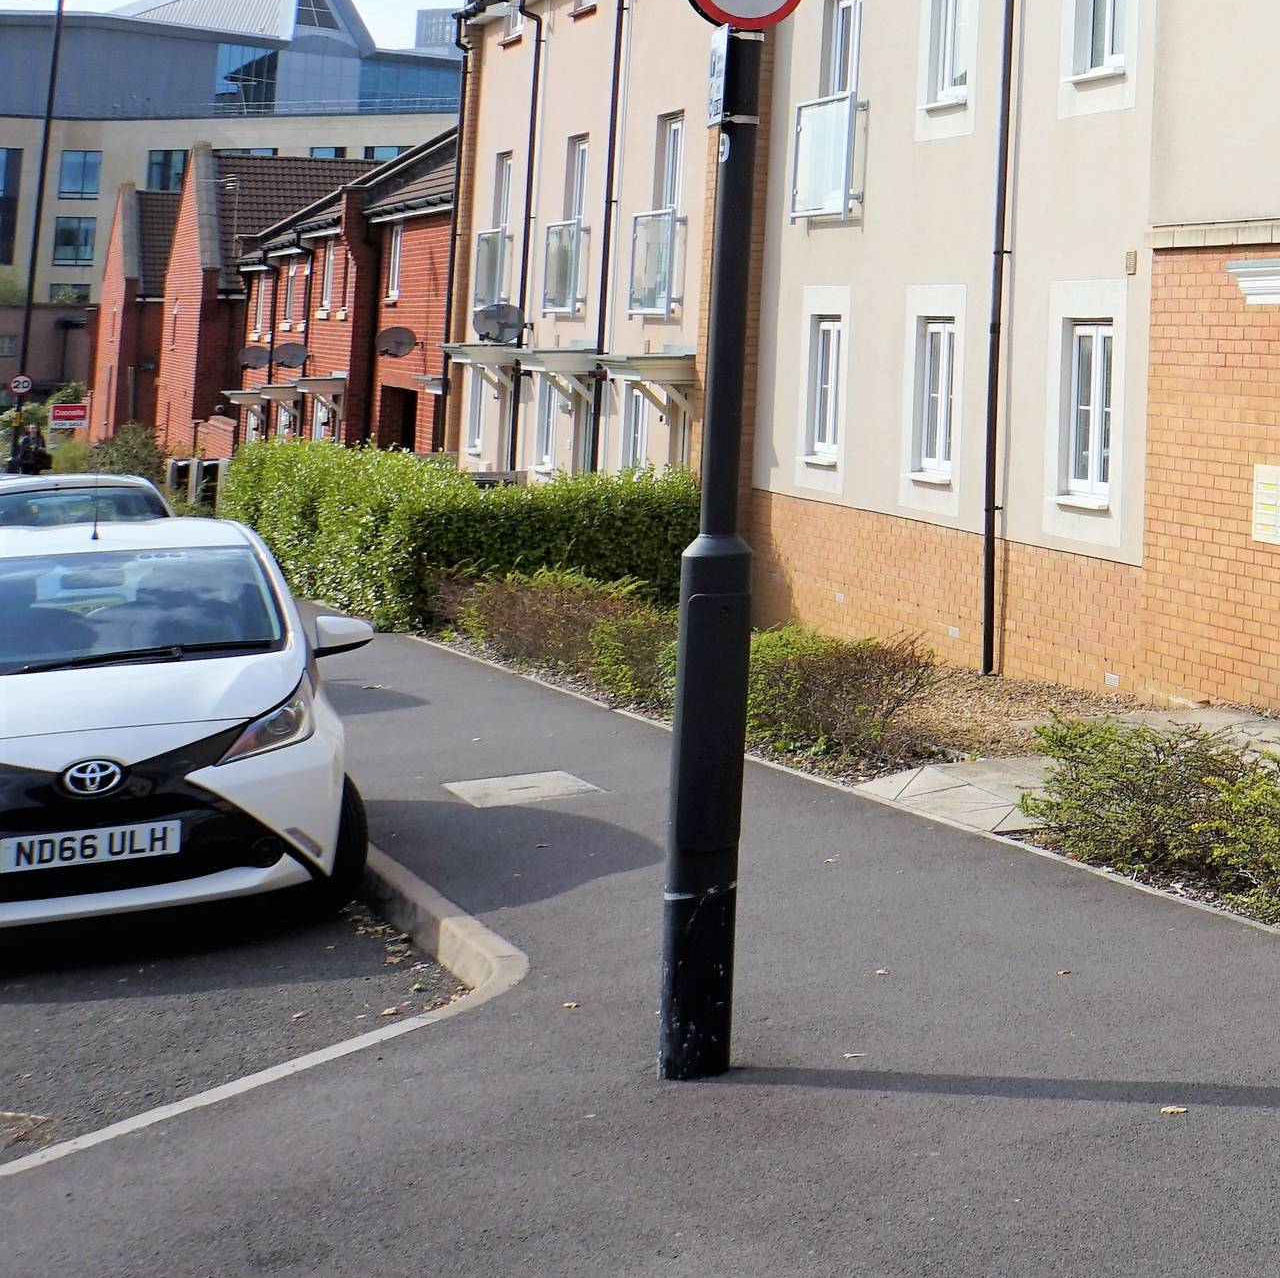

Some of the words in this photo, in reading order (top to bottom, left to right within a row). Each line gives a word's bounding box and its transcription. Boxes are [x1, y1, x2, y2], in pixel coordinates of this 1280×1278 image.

[12, 380, 30, 389] 20
[15, 835, 98, 867] ND66
[109, 826, 169, 855] ULH
